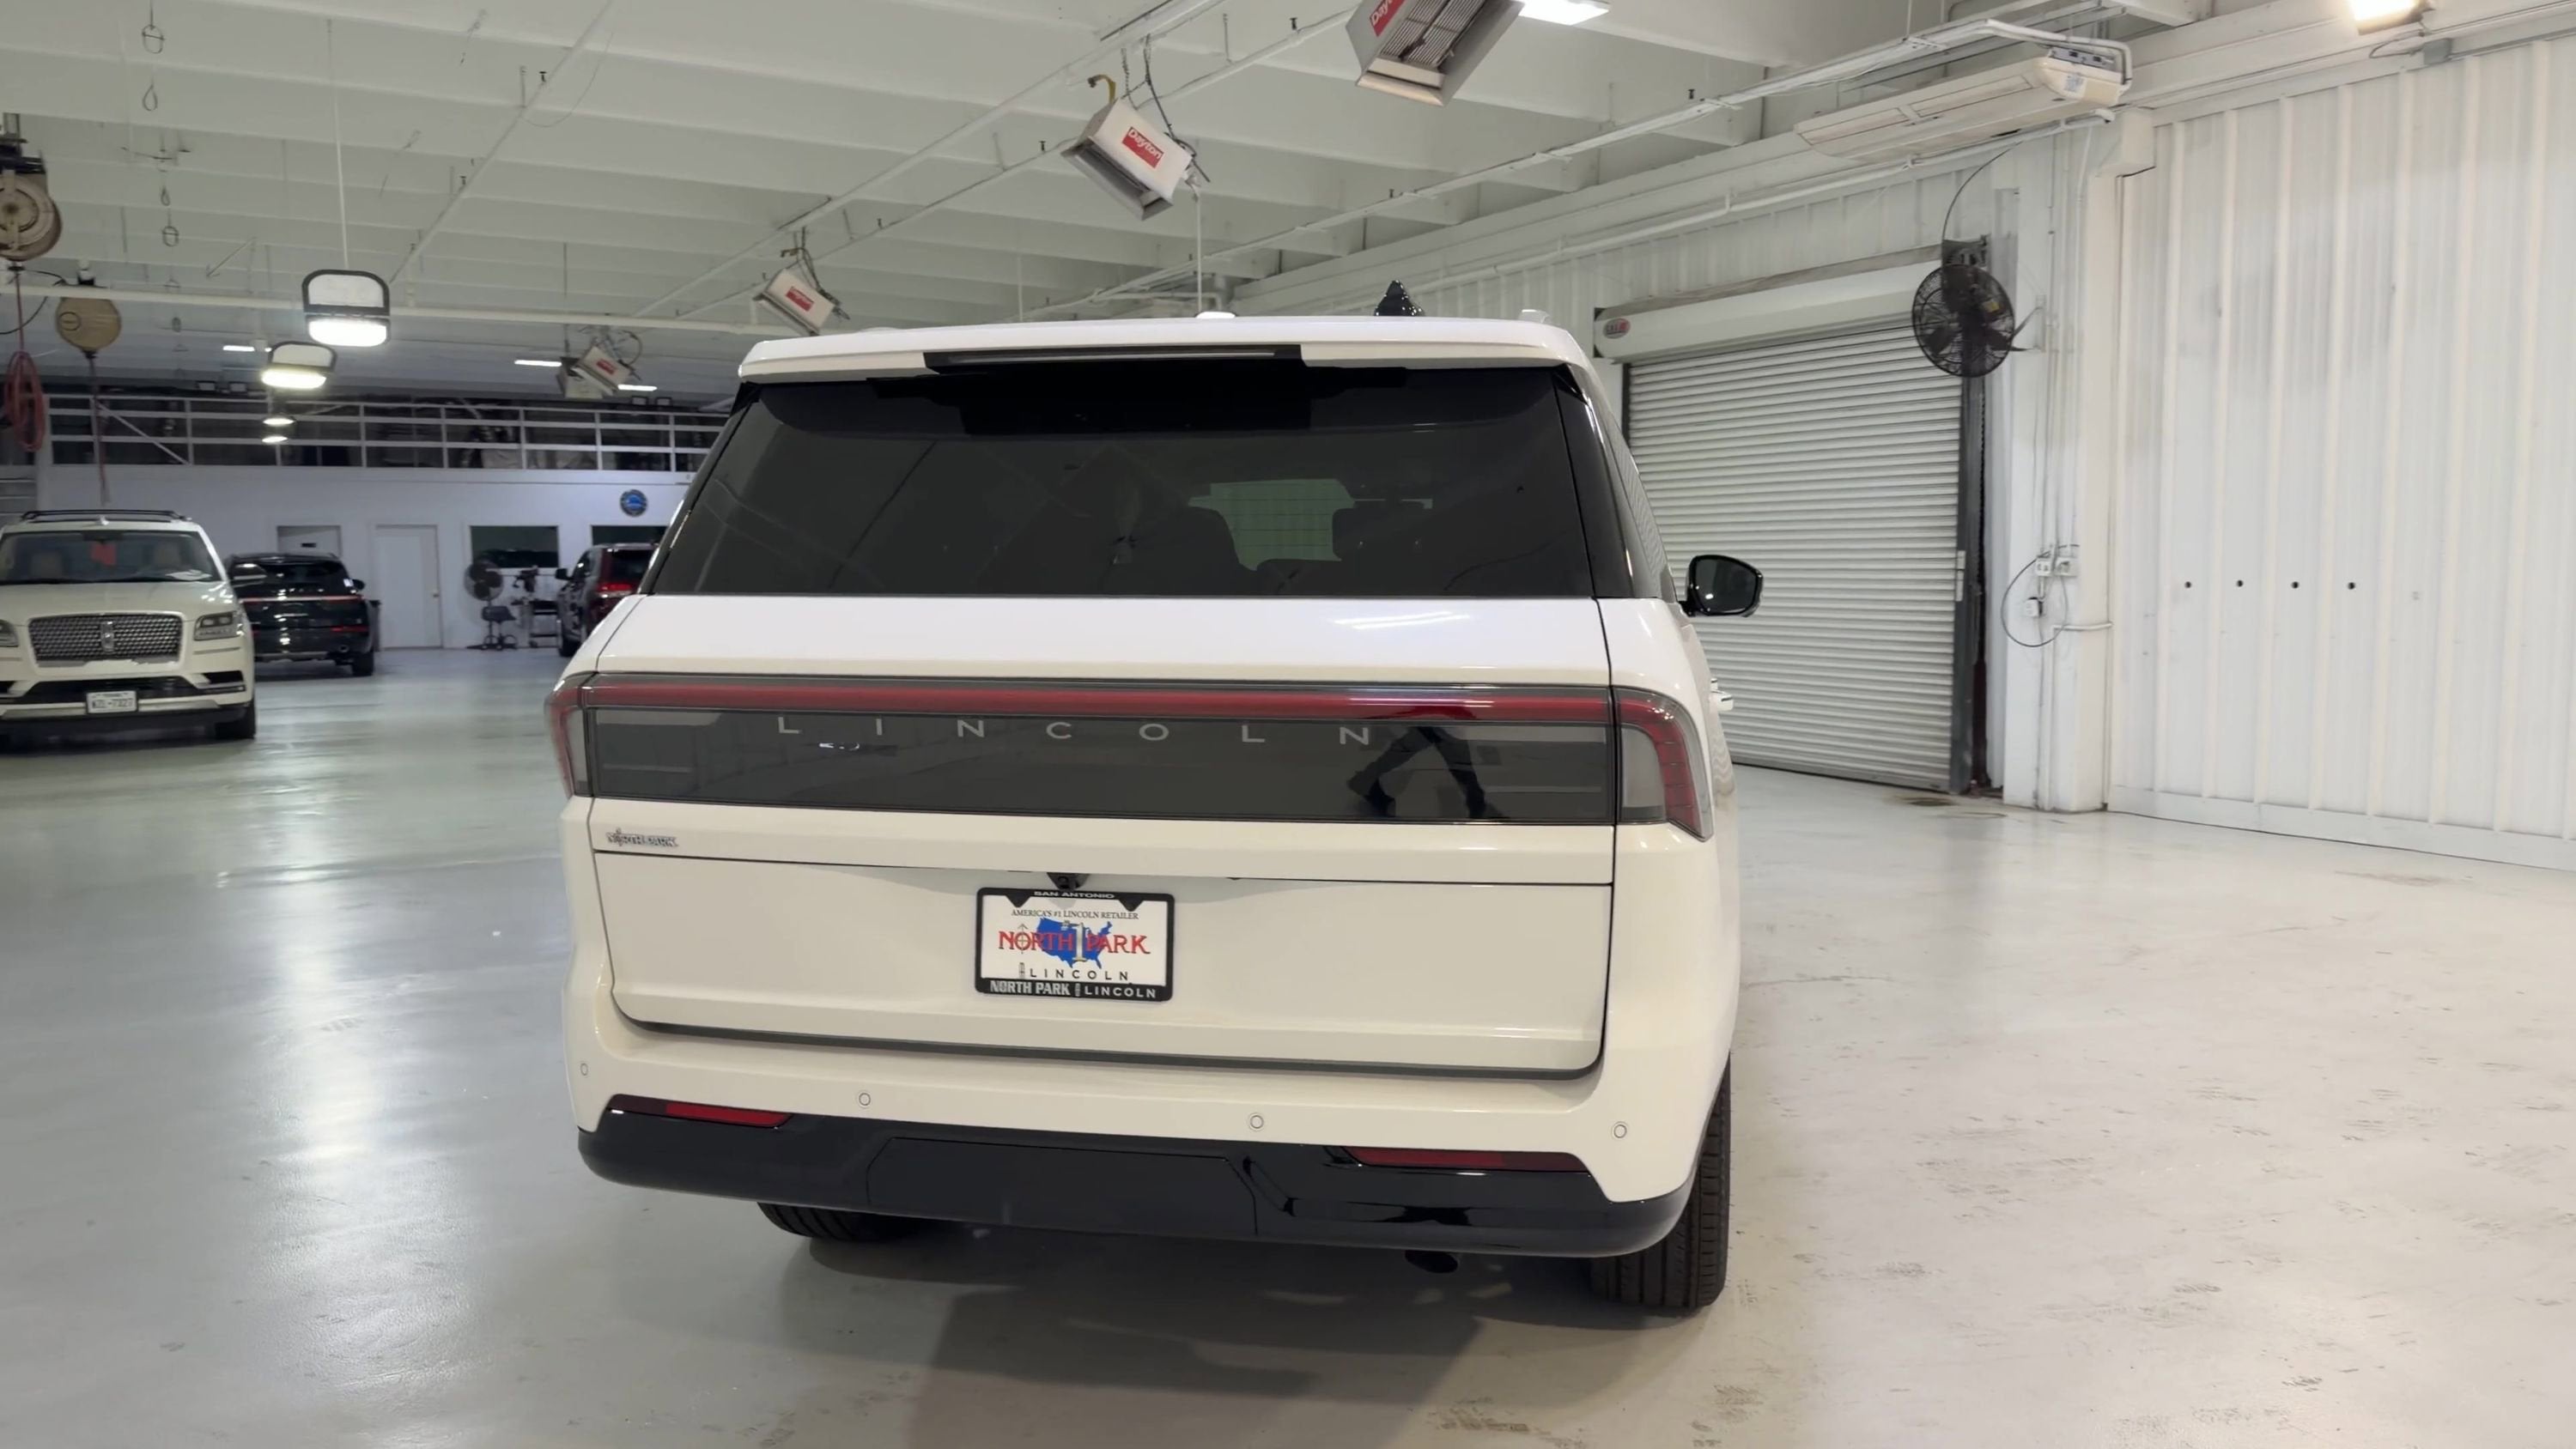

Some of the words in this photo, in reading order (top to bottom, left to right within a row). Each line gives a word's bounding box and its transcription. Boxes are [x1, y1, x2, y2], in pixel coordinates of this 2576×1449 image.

[1128, 129, 1160, 160] Dayton
[778, 717, 1370, 745] LINCOLN
[1012, 909, 1052, 918] AMERICA'S
[1063, 911, 1099, 919] LINCOLN
[1101, 912, 1139, 920] RETAILER
[998, 931, 1072, 951] NORTH
[1086, 933, 1151, 955] PARK
[1030, 968, 1128, 980] LINCOLN
[990, 979, 1032, 994] NORTH
[1036, 982, 1071, 996] PARK
[1084, 985, 1157, 998] LINCOLN
